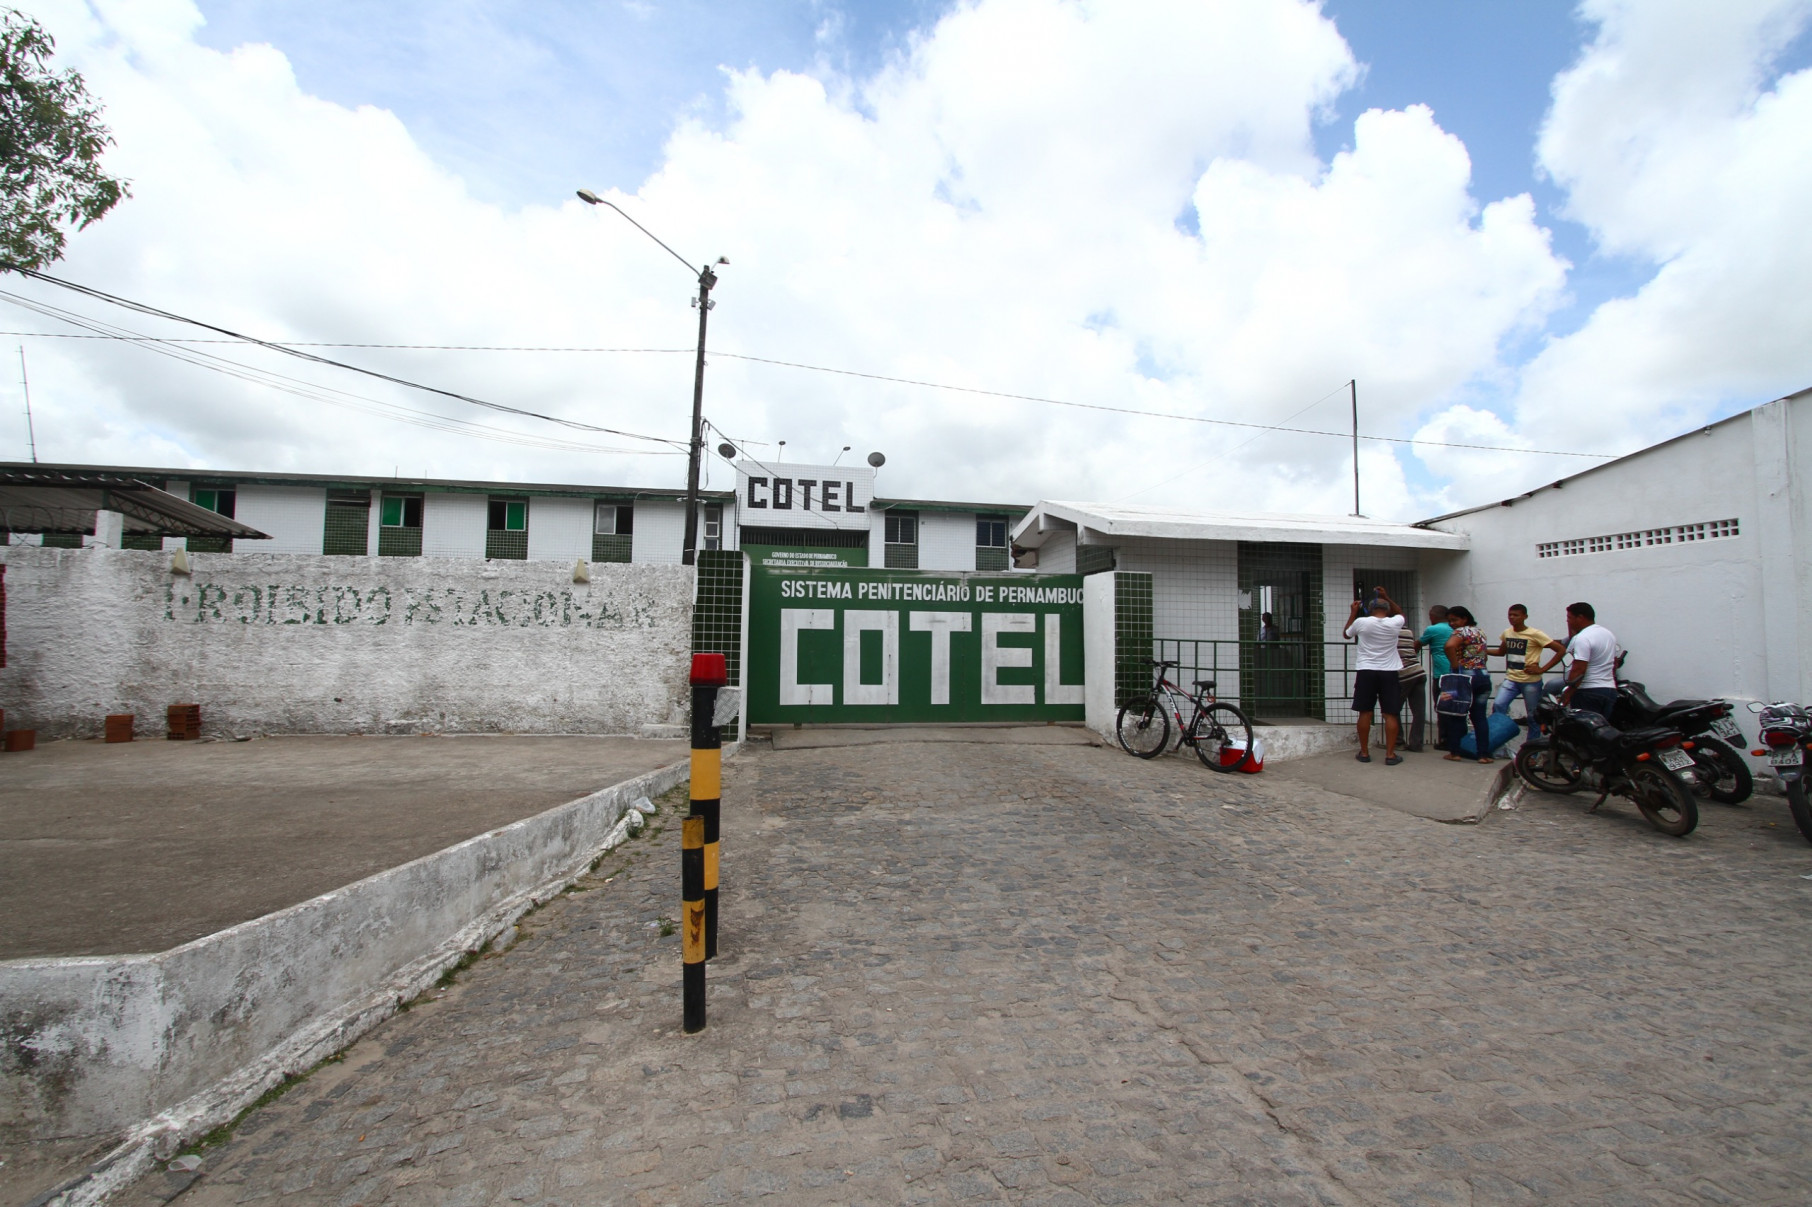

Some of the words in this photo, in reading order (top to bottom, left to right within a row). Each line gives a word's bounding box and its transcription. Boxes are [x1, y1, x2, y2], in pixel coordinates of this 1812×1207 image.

[748, 476, 865, 513] COTEL
[781, 580, 852, 599] SISTEMA
[858, 581, 970, 602] PENITENCIÁRIO
[976, 585, 994, 602] DE
[999, 586, 1084, 604] PERNAMBUC
[779, 608, 1086, 706] COTEL
